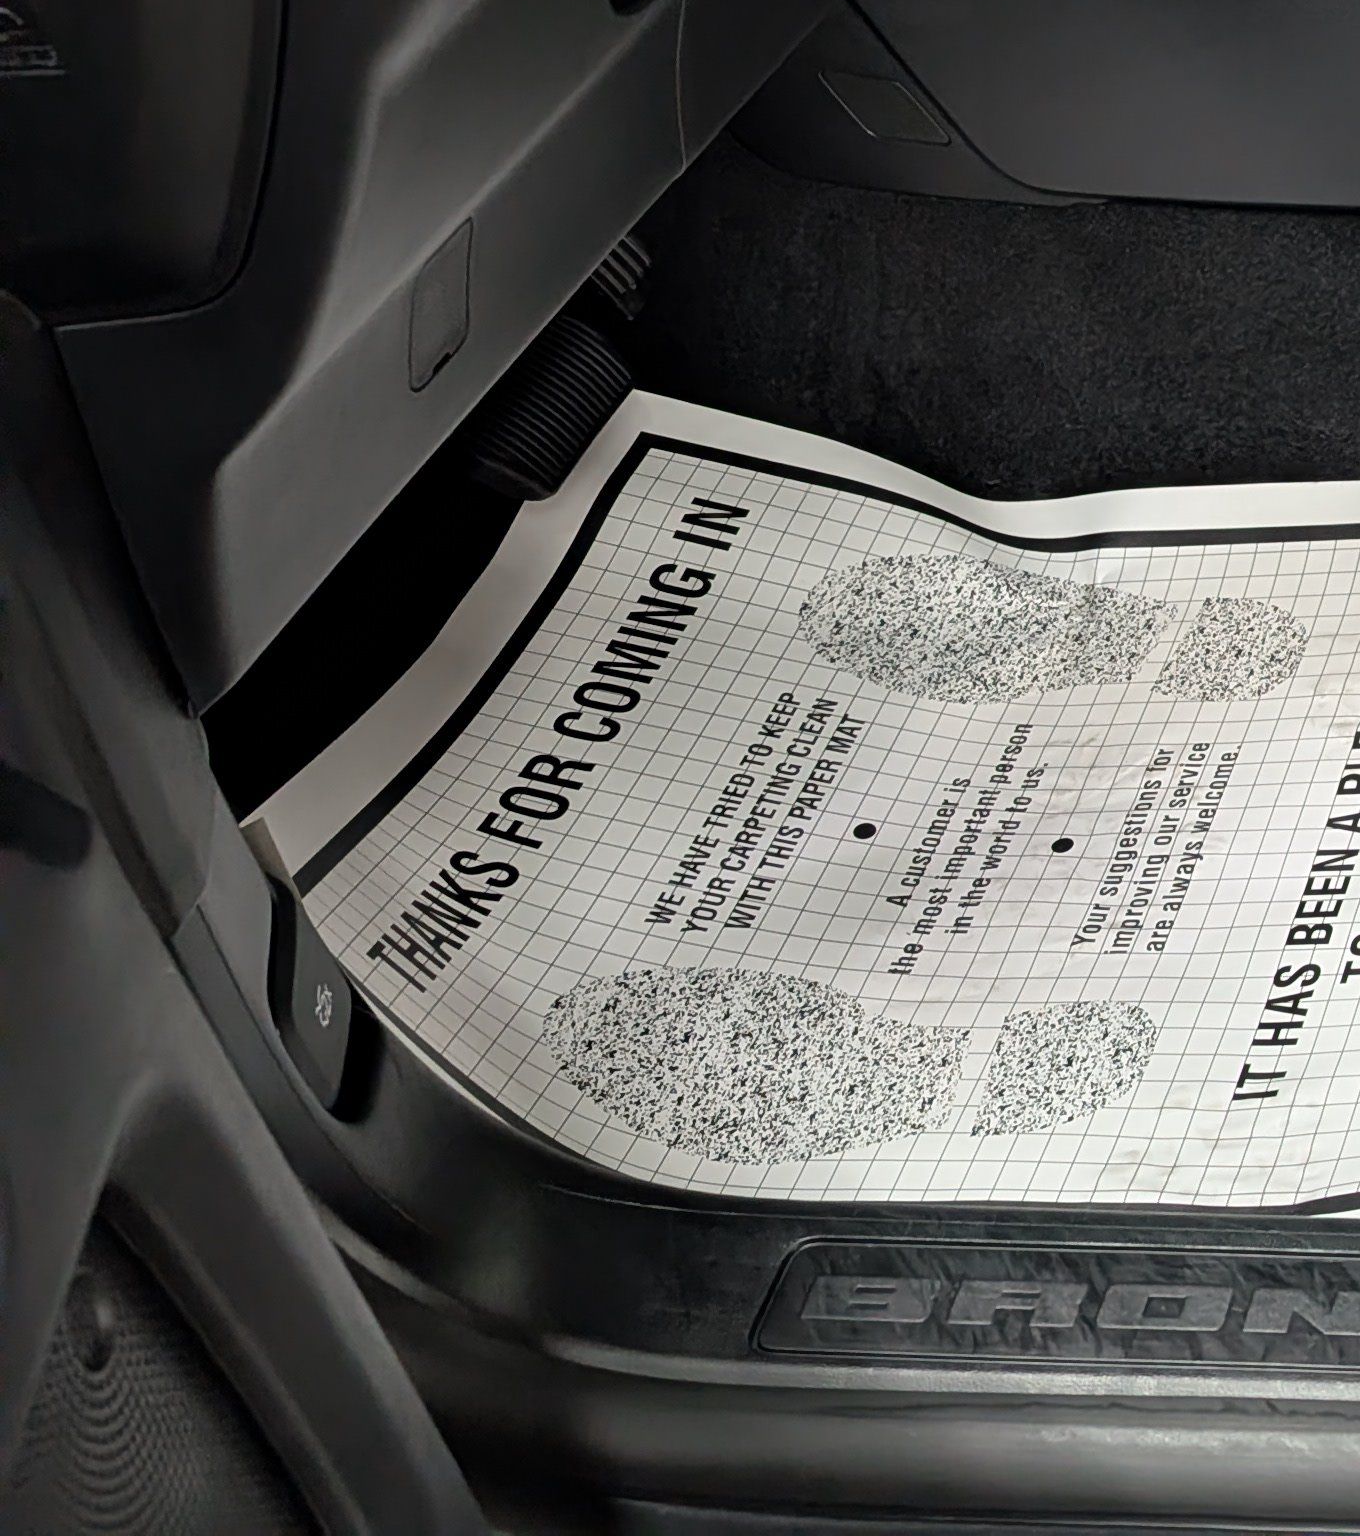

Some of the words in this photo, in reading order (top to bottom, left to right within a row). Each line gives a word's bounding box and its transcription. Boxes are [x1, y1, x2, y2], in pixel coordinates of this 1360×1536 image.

[367, 850, 520, 993] THANKS
[476, 753, 597, 849] FOR
[553, 563, 717, 742] COMING
[673, 496, 750, 551] IN
[644, 891, 685, 924] WE
[668, 835, 720, 887] HAVE
[702, 773, 755, 828] TRIED
[739, 743, 773, 766] TO
[758, 692, 801, 738] KEEP
[1005, 797, 1032, 813] to
[1021, 762, 1049, 789] us.
[680, 877, 736, 932] YOUR
[720, 762, 802, 872] CARPETING
[787, 697, 839, 757] CLEAN
[724, 876, 776, 929] WITH
[758, 825, 805, 869] THIS
[788, 758, 843, 821] PAPER
[826, 713, 866, 754] MAT
[886, 894, 912, 908] A
[901, 799, 960, 888] customer
[944, 777, 971, 793] is
[888, 943, 923, 975] the
[913, 887, 952, 935] most
[935, 789, 1001, 880] important
[989, 723, 1033, 784] person
[980, 820, 1021, 871] world
[1070, 903, 1110, 947] Your
[1100, 779, 1162, 897] suggestions
[1145, 748, 1175, 772] for
[1104, 854, 1169, 955] improving
[1154, 814, 1180, 846] our
[1169, 742, 1210, 809] service
[1146, 919, 1174, 952] are
[1162, 841, 1203, 912] always
[1191, 745, 1242, 835] welcome.
[944, 915, 973, 934] in
[958, 877, 991, 908] the
[1286, 849, 1360, 946] BEEN
[1251, 963, 1321, 1046] HAS
[1231, 1063, 1288, 1101] IT
